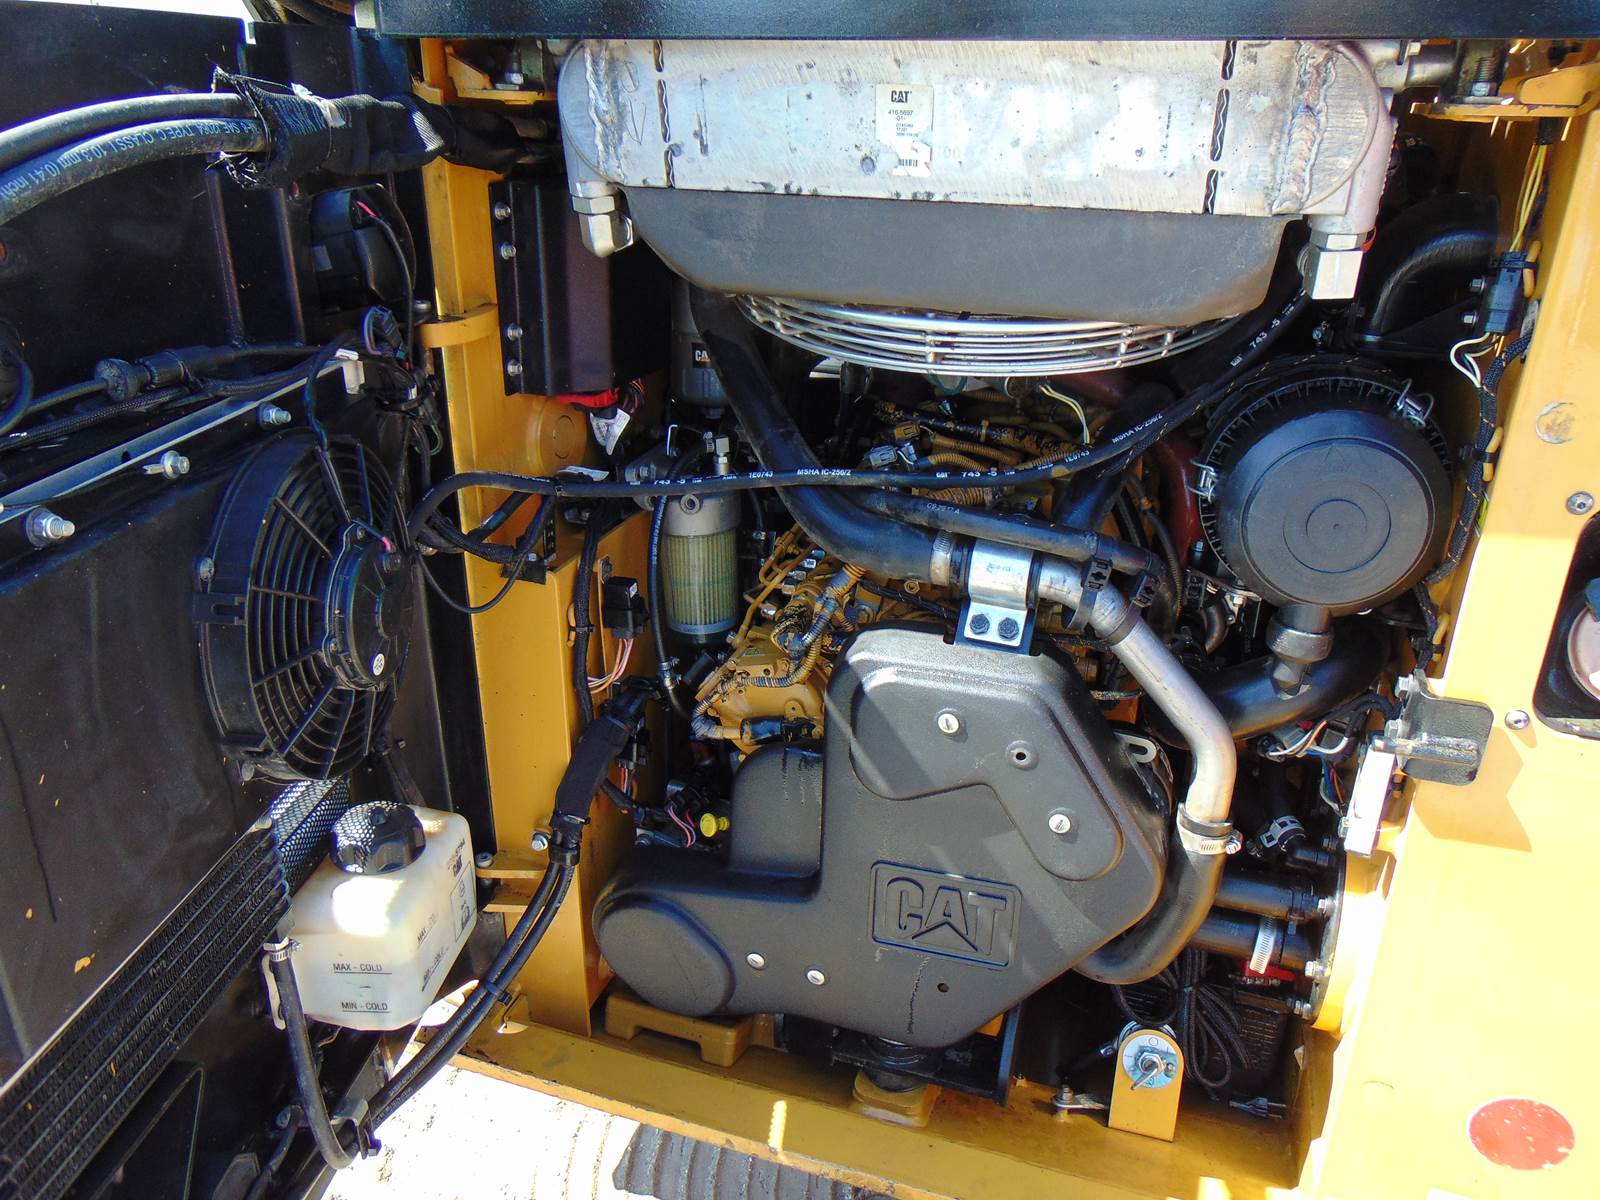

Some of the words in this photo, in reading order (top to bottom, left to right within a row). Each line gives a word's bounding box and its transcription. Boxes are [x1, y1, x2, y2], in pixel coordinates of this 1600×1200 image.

[890, 90, 910, 103] CAT
[171, 123, 196, 139] TYPE
[120, 132, 154, 151] CLASS
[1249, 332, 1268, 349] 743
[695, 350, 710, 362] CA
[749, 471, 774, 479] 1E0743
[797, 468, 820, 476] MSHA
[821, 468, 851, 476] IC-256/2
[885, 876, 1008, 957] CAT
[332, 963, 352, 972] MAX
[360, 963, 383, 973] COLD
[341, 1002, 358, 1010] MIN
[365, 1003, 389, 1011] COLD
